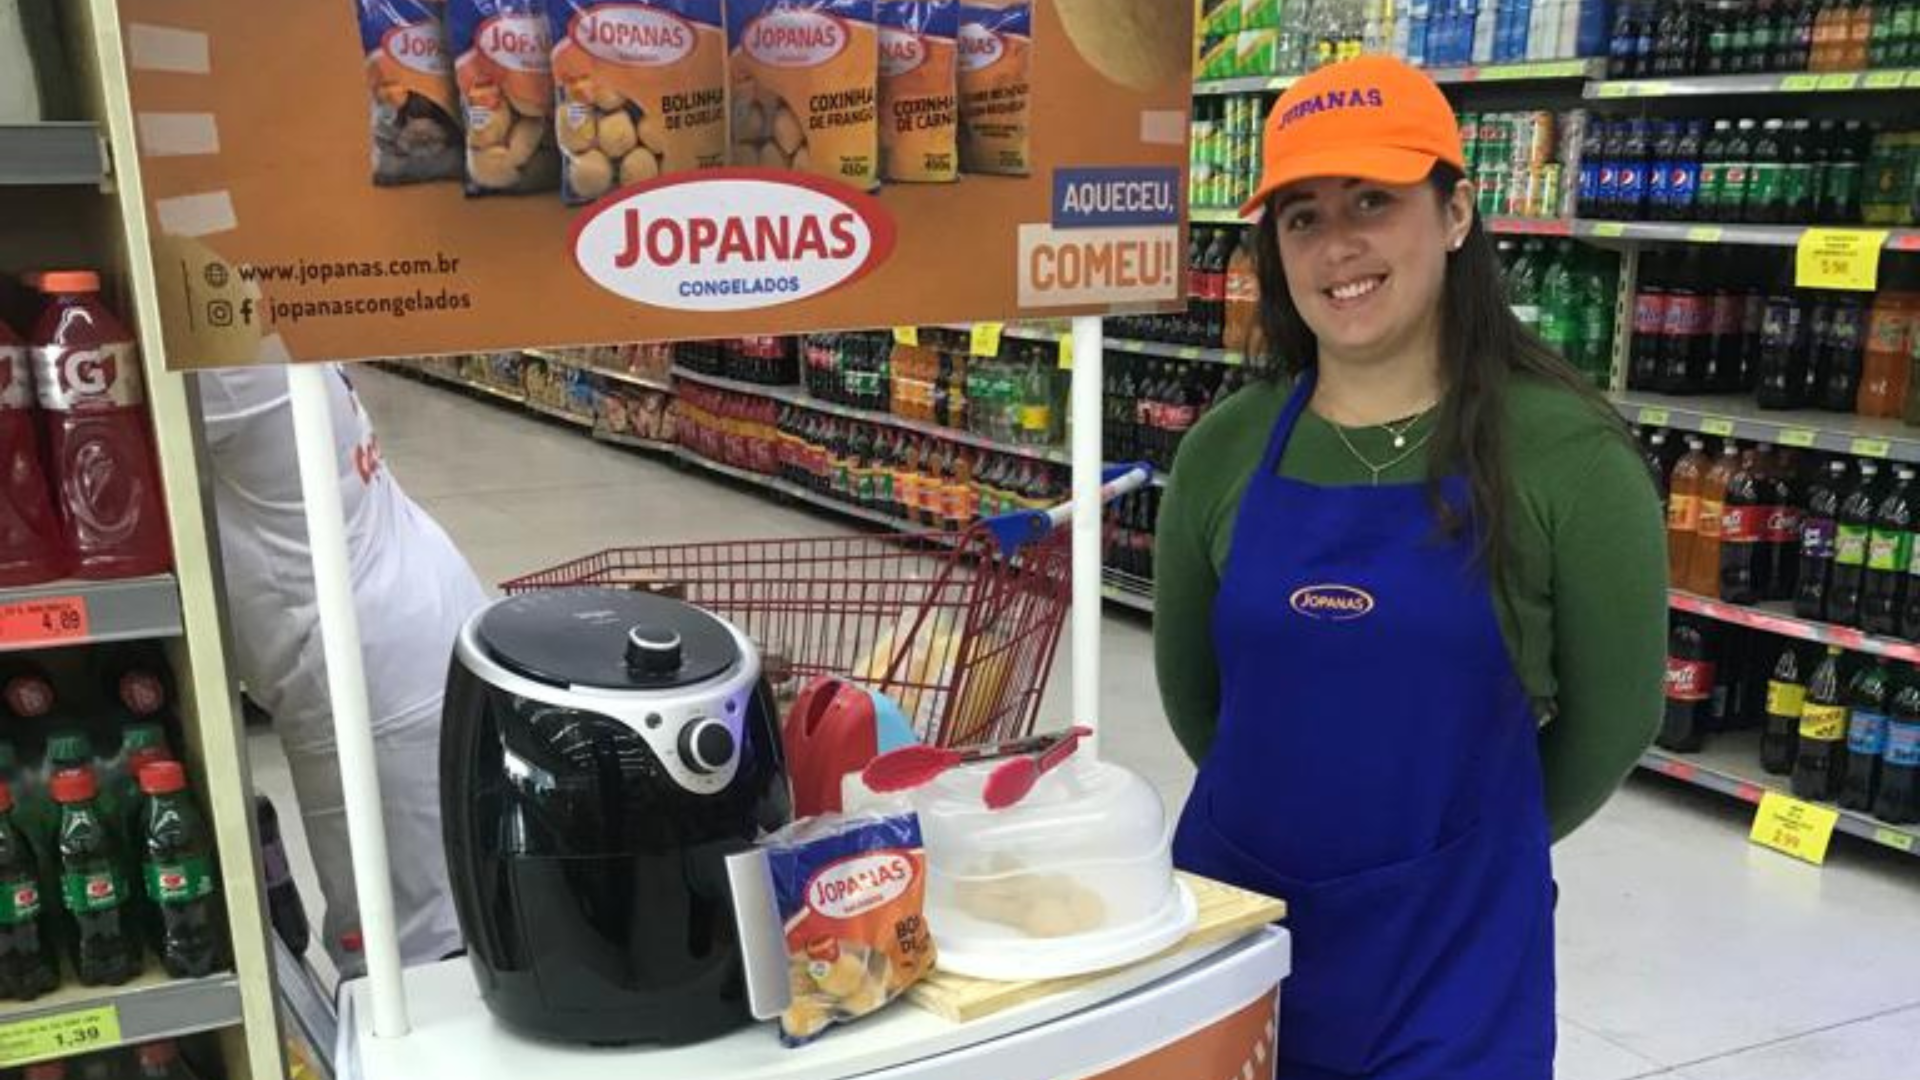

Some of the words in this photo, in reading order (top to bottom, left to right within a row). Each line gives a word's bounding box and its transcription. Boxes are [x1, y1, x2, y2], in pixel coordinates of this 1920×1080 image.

[586, 16, 684, 48] JOPANAS
[752, 25, 836, 48] JOPANAS
[809, 114, 824, 130] DE
[896, 116, 913, 133] DE
[1277, 88, 1383, 130] JOPANAS
[1062, 182, 1174, 215] AQUECEU,
[615, 208, 857, 269] JOPANAS
[238, 253, 461, 286] www.jopanas.com.br
[1030, 240, 1173, 291] COMEU!
[679, 276, 801, 298] CONGELADOS
[270, 289, 471, 324] jopanascongelados
[64, 350, 107, 394] G
[1300, 592, 1364, 610] JOPANAS
